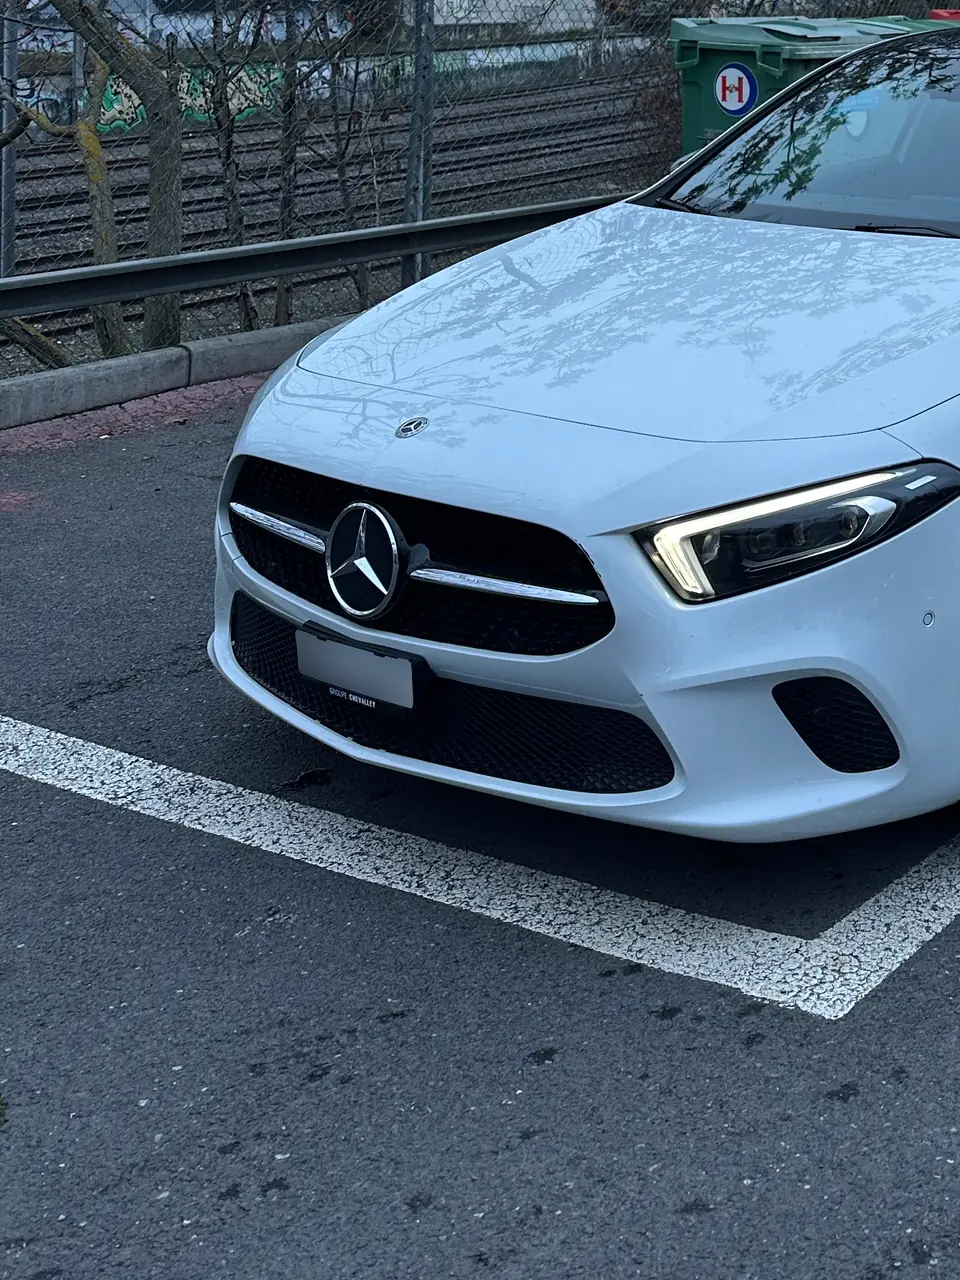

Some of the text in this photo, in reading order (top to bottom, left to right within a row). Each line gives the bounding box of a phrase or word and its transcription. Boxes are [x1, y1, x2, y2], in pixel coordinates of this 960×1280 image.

[721, 75, 744, 103] H
[329, 687, 376, 708] GROUPE CHEVALLEY
